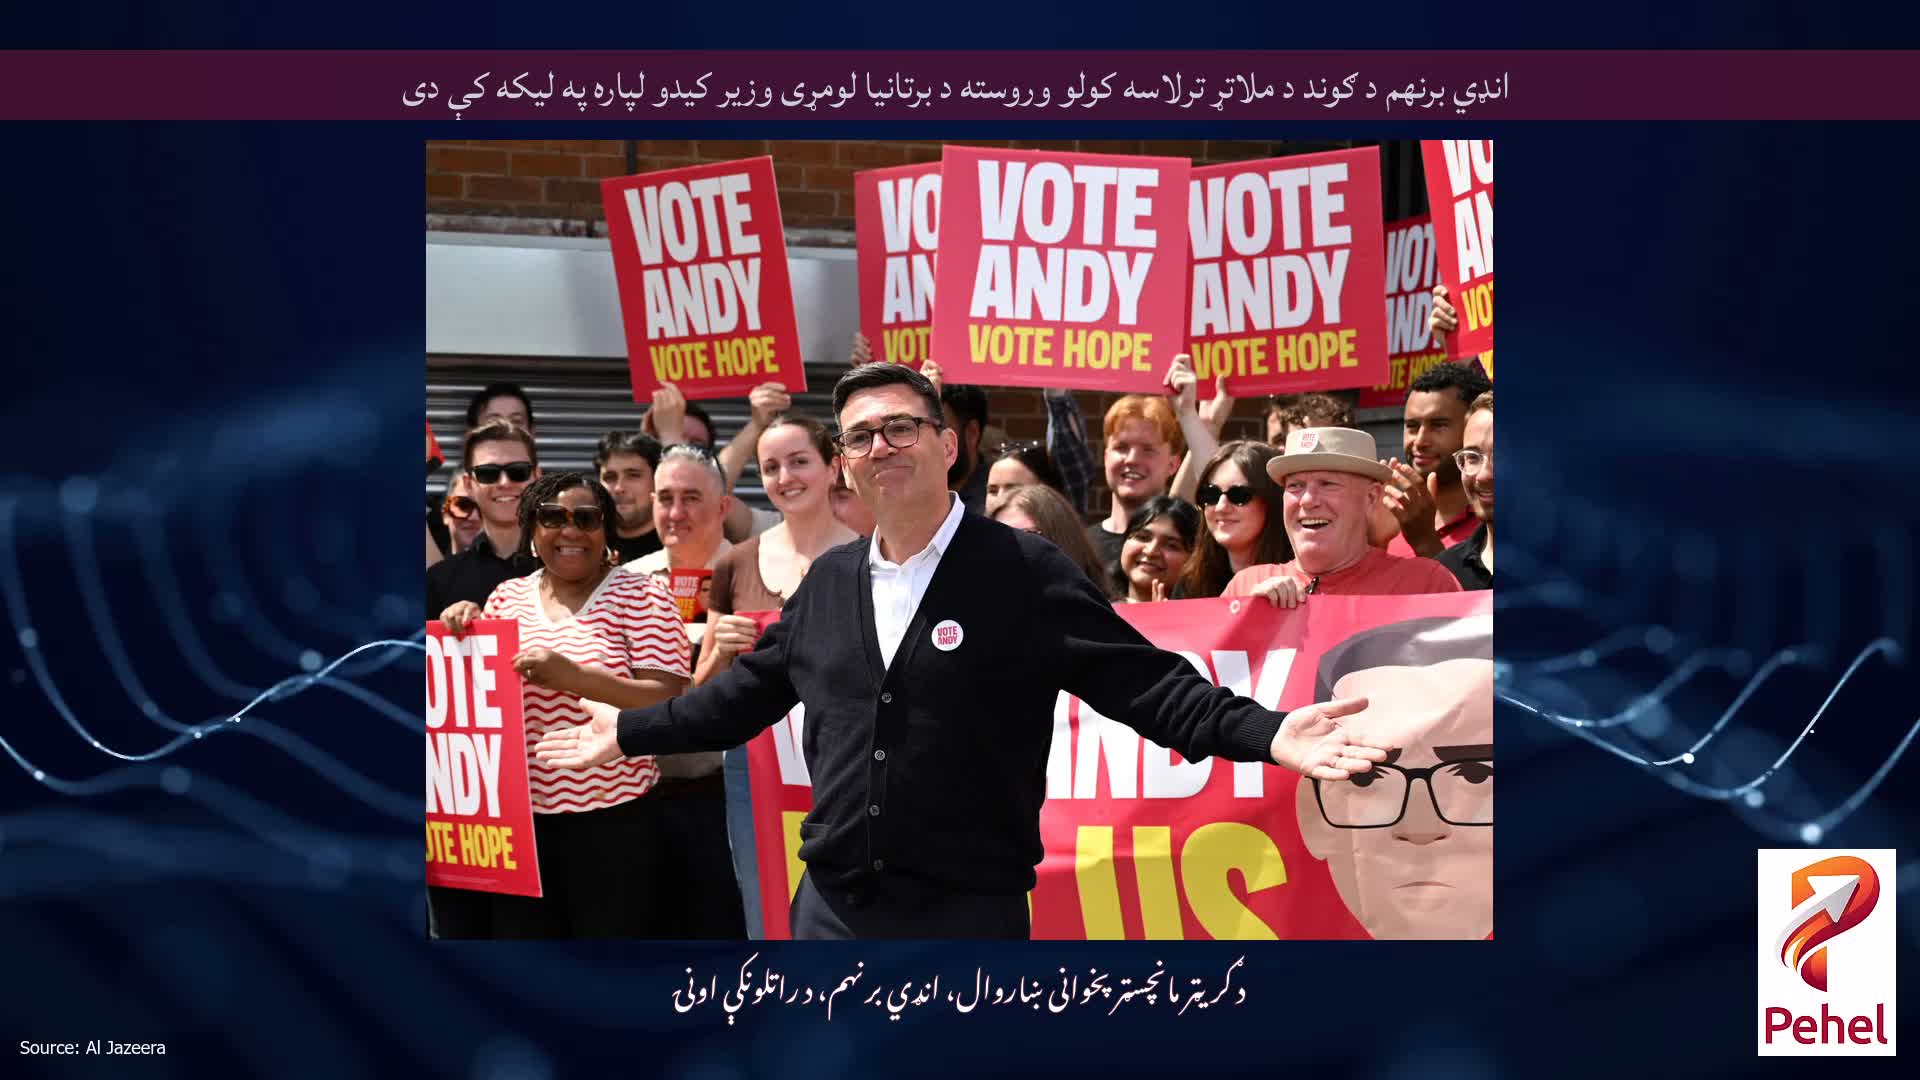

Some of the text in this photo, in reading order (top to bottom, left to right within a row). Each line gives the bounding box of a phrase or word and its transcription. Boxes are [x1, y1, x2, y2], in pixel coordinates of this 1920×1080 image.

[624, 173, 761, 266] VOTE
[977, 160, 1159, 248] VOTE
[1188, 163, 1352, 259] VOTE
[643, 257, 762, 340] ANDY
[970, 244, 1154, 326] ANDY
[1190, 249, 1352, 337] ANDY
[649, 335, 780, 383] VOTE HOPE
[968, 324, 1153, 372] VOTE HOPE
[1190, 328, 1359, 381] VOTE HOPE
[937, 626, 958, 637] VOTE
[937, 635, 958, 646] ANDY
[426, 634, 503, 730] OTE
[426, 733, 502, 819] NDY
[459, 823, 518, 871] HOPE
